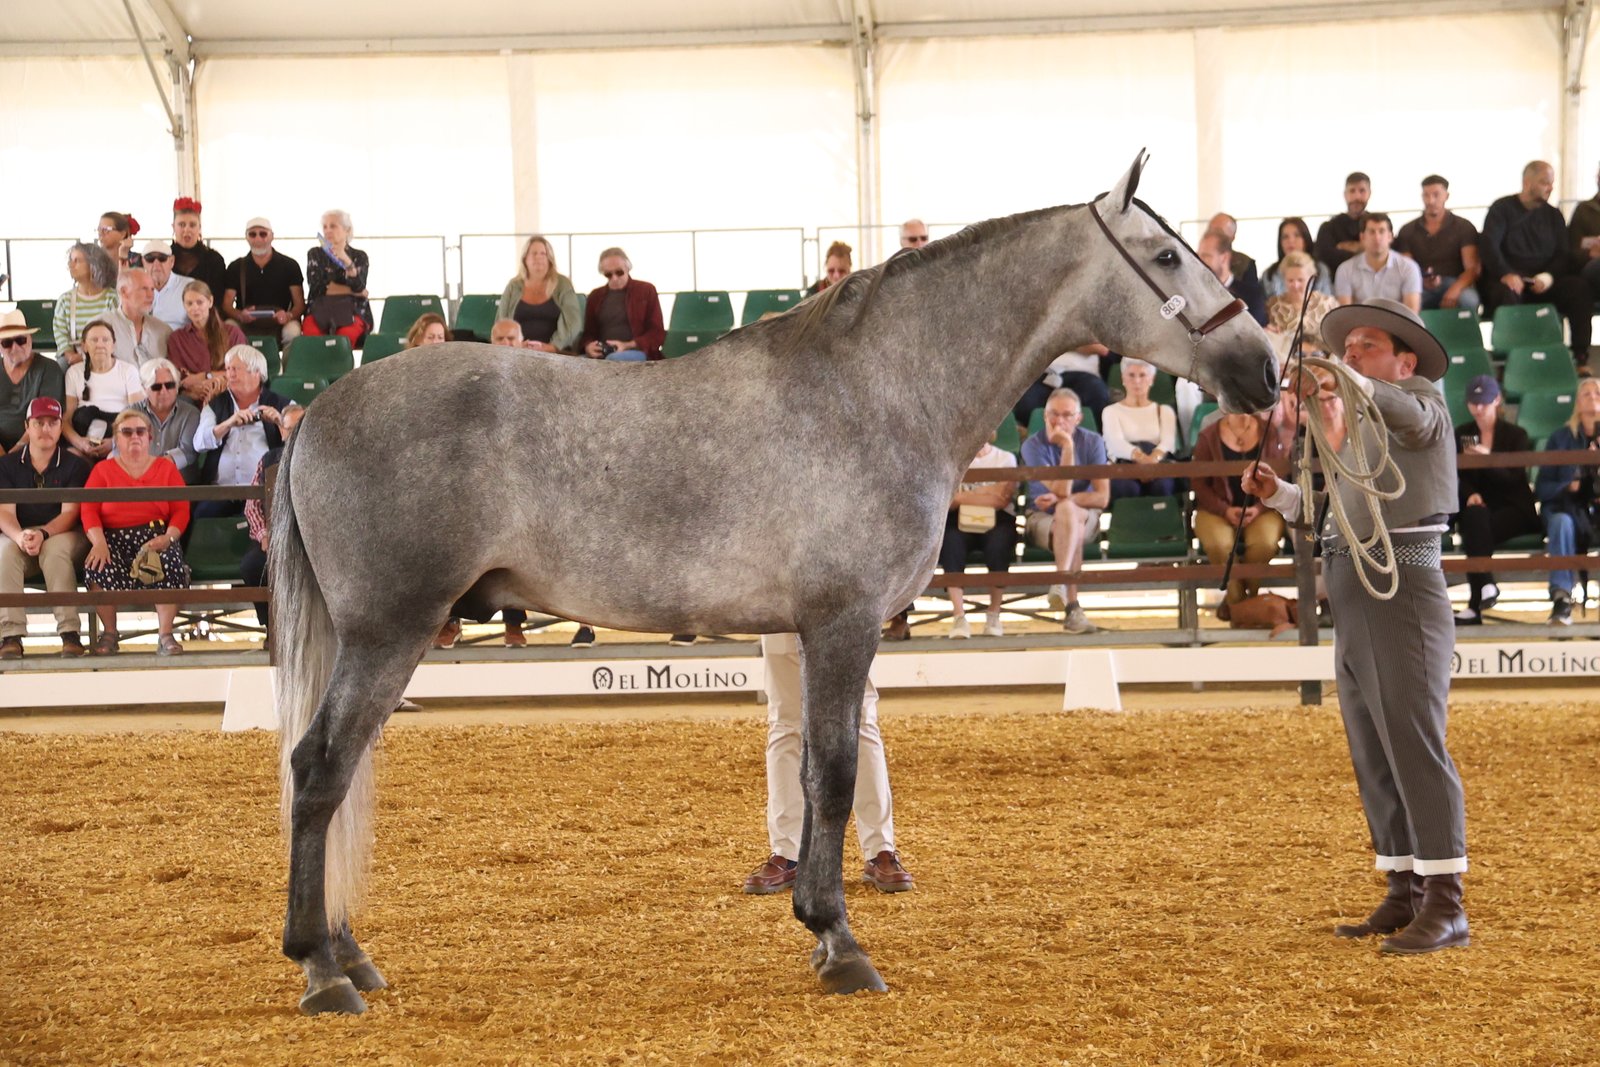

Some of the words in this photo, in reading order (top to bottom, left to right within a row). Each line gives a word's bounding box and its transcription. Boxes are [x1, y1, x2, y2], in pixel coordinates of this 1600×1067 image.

[1162, 297, 1181, 315] 803
[1468, 658, 1489, 674] EL
[619, 674, 639, 689] EL
